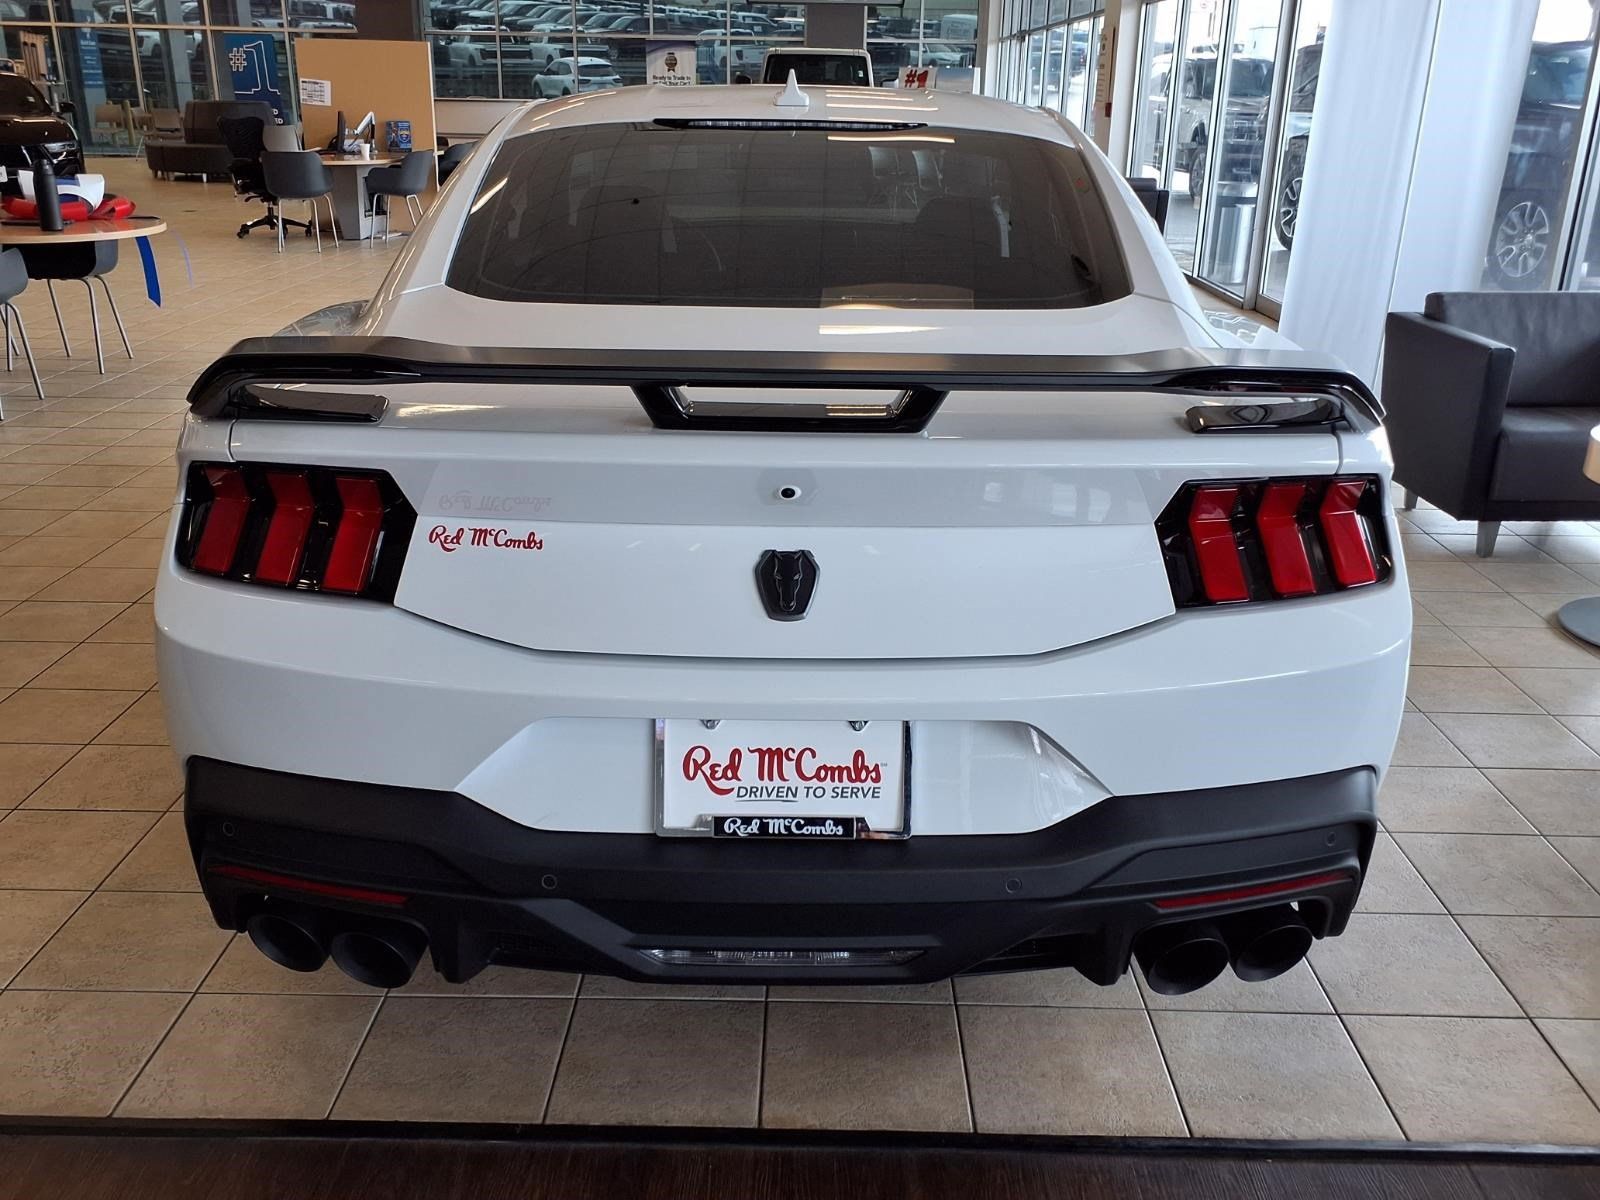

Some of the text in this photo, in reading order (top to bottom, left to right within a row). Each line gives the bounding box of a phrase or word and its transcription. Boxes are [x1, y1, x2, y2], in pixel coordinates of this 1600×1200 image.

[229, 40, 280, 95] #1
[904, 69, 928, 88] #1
[429, 525, 543, 552] Red McCombs
[682, 745, 742, 796] Red
[747, 747, 882, 784] McCombs
[736, 786, 881, 798] DRIVEN TO SERVE
[723, 817, 843, 837] Red McCombs
